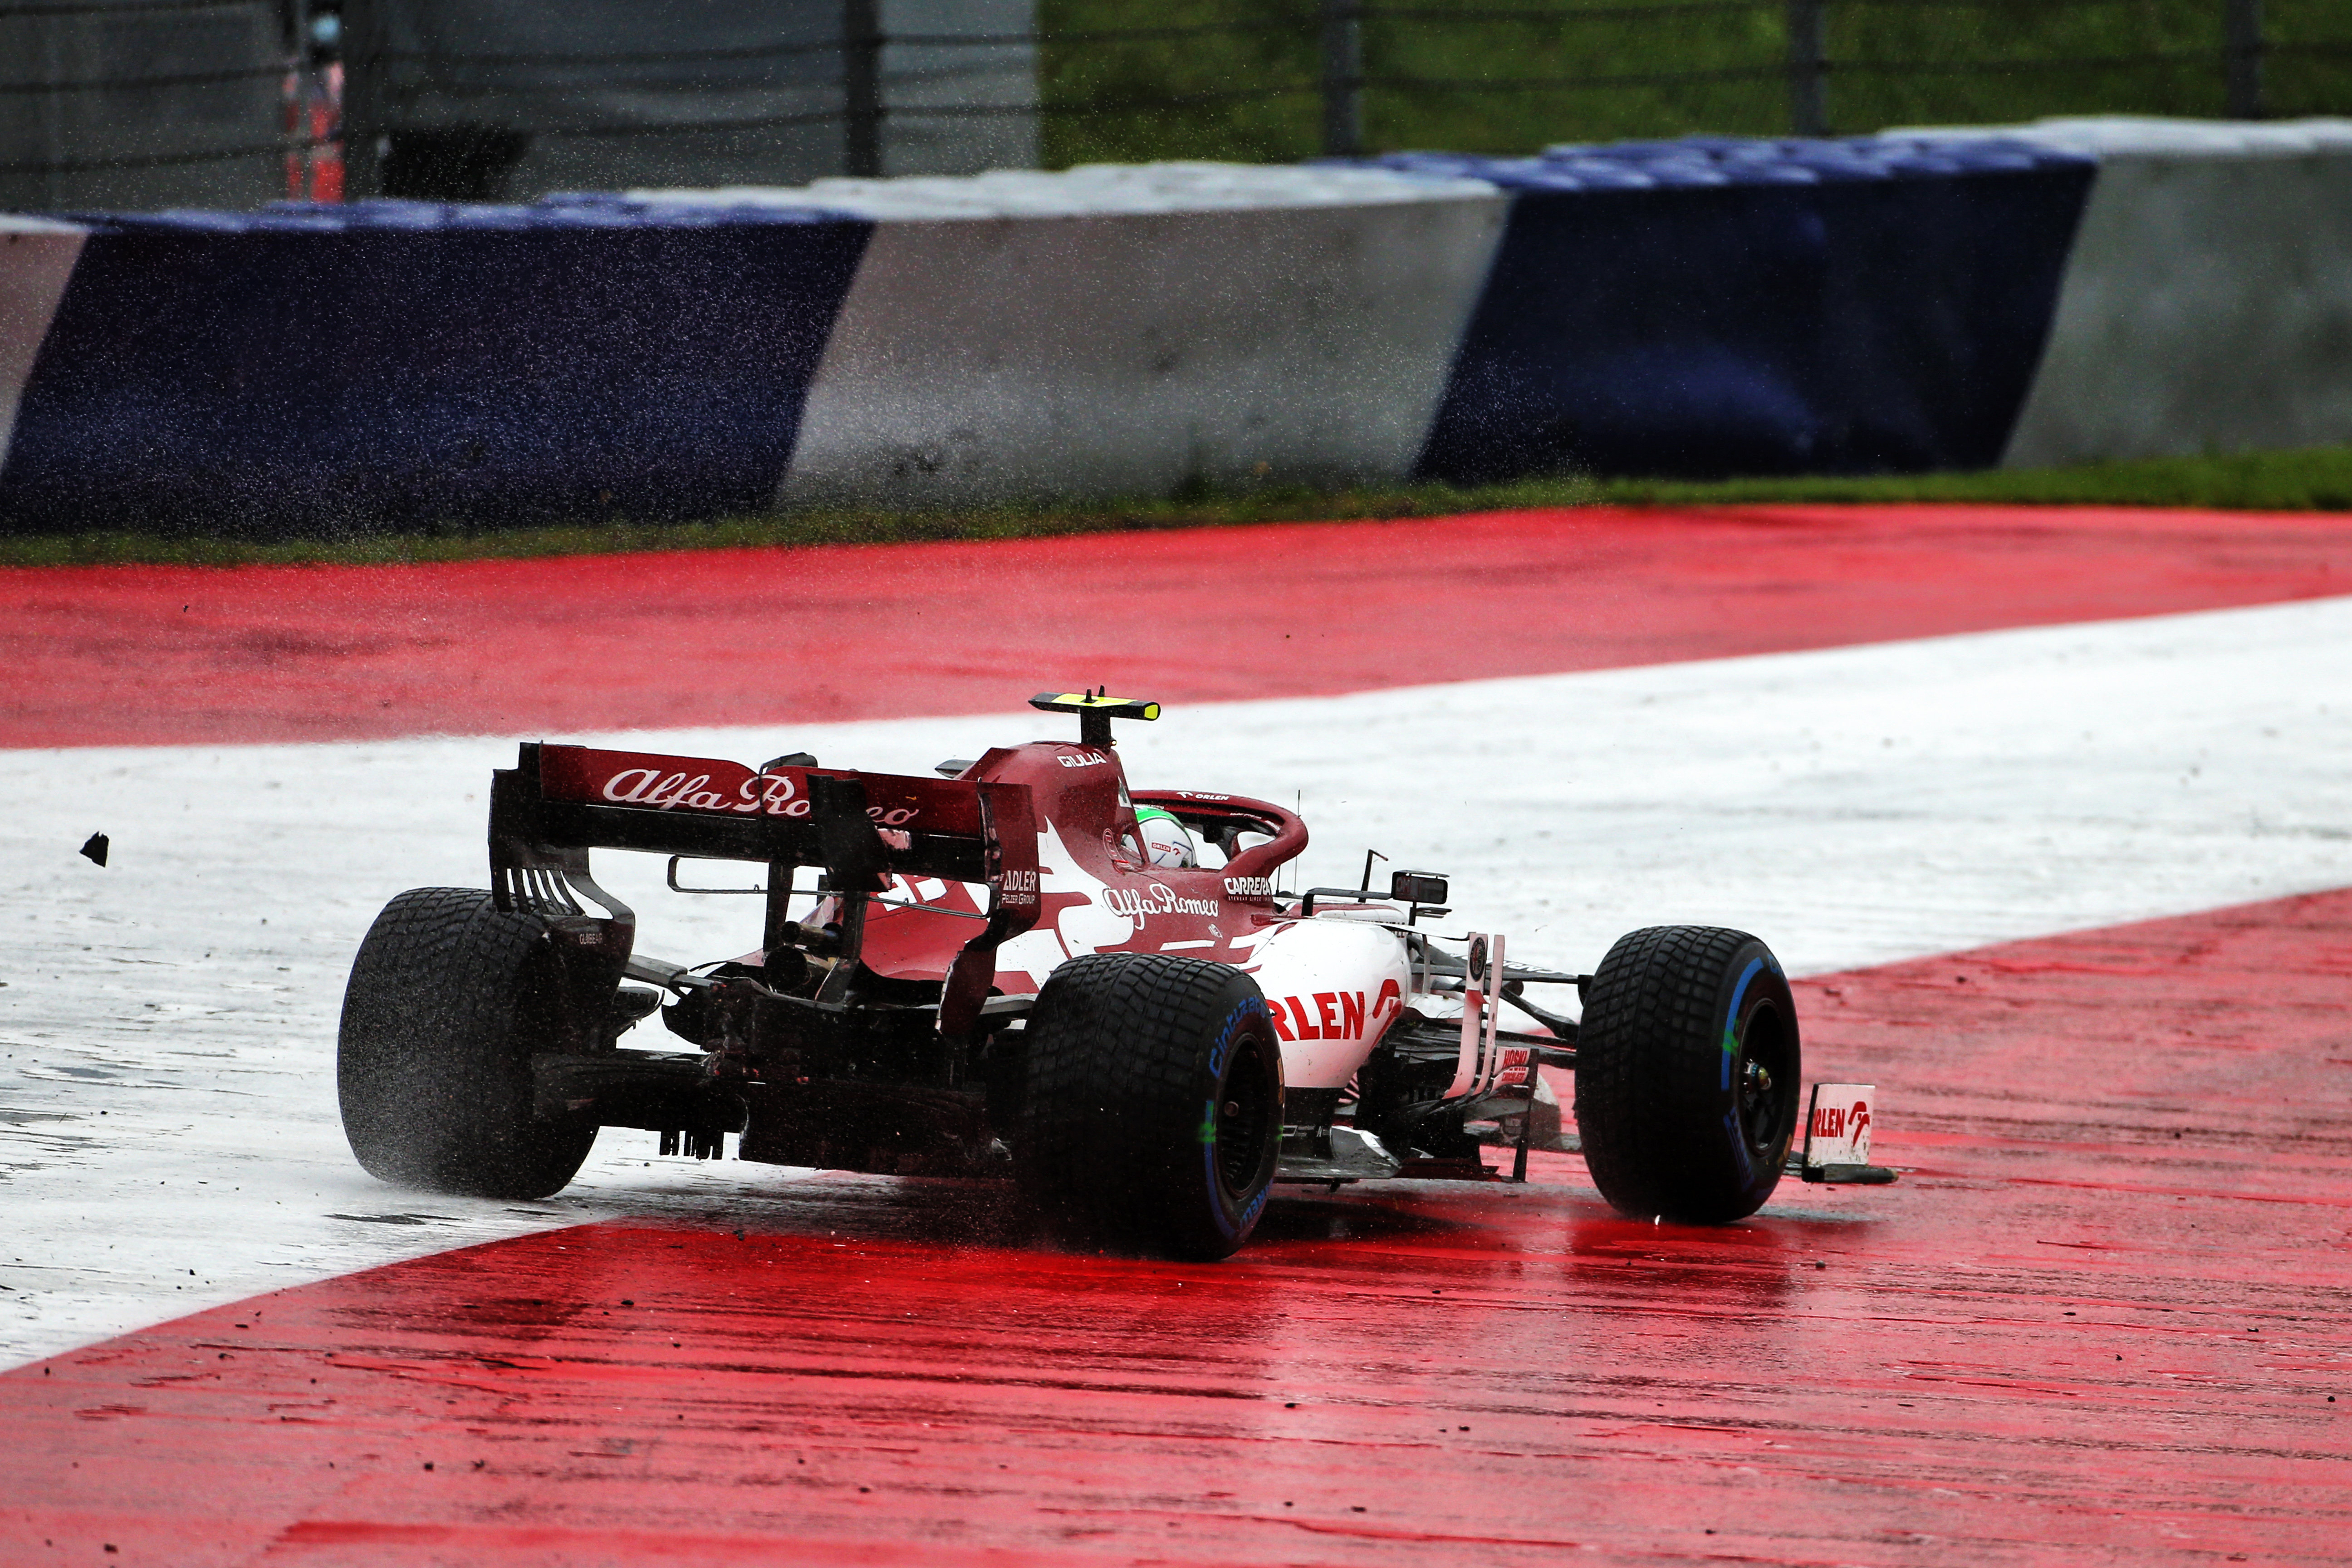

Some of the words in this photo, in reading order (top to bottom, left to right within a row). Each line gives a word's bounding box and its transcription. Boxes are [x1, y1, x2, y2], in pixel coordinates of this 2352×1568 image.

[1057, 752, 1107, 767] GIULIA
[603, 769, 732, 810] Alfa
[732, 774, 920, 825] Roeo
[1152, 843, 1170, 852] ORLEN
[1003, 870, 1036, 892] ADLER
[1224, 877, 1271, 895] CARRERA
[1102, 887, 1162, 931] Alfa
[1149, 882, 1219, 917] Romeo
[1266, 991, 1365, 1042] RLEN
[1812, 1108, 1846, 1138] RLEN
